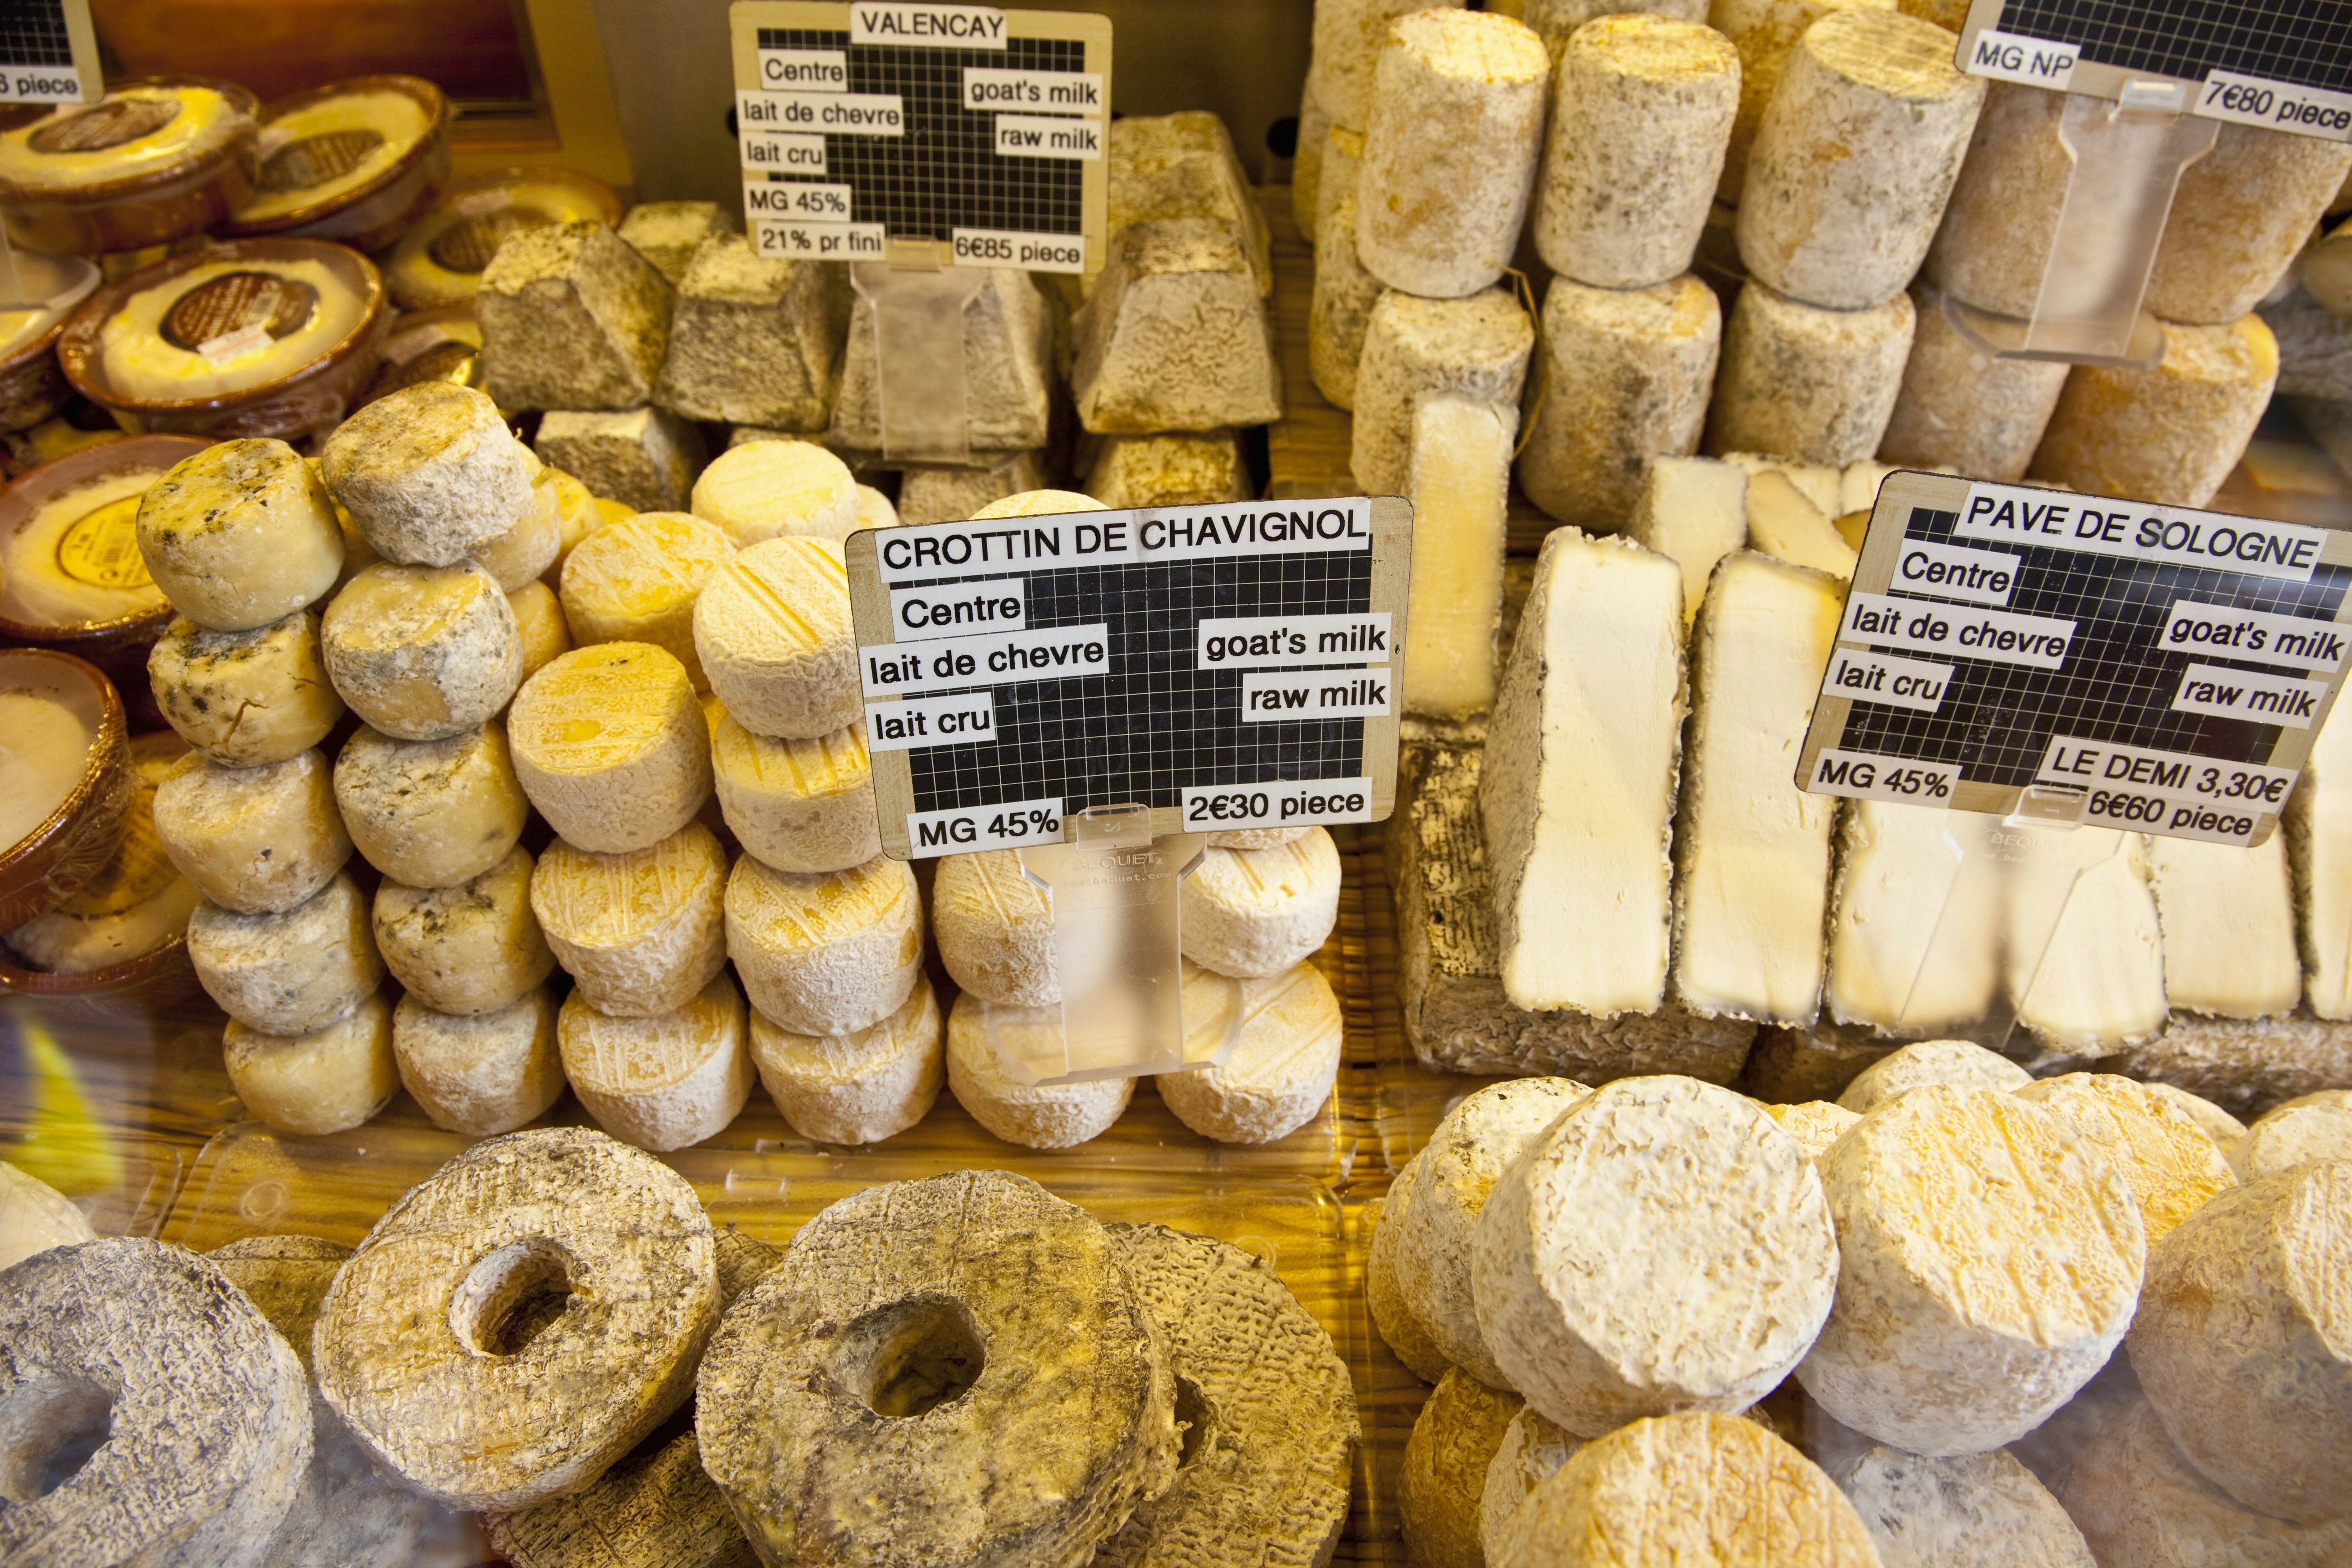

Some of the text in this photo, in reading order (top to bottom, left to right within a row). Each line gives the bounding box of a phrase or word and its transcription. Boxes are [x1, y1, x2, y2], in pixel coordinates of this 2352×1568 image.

[861, 11, 1003, 37] VALENCAY
[765, 58, 844, 82] Centre
[1975, 41, 2073, 77] MG NP
[16, 73, 78, 97] piece
[972, 80, 1097, 104] goat's milk
[745, 100, 899, 126] lait de chevre
[2207, 81, 2352, 130] 7€80 piece
[748, 141, 822, 164] lait cru
[1002, 129, 1097, 150] raw milk
[750, 190, 845, 213] MG 45%
[763, 229, 882, 252] 21% pr fini
[955, 237, 1080, 264] 6€85 piece
[884, 509, 1366, 569] CROTTIN DE CHAVIGNOL
[1967, 496, 2319, 568] PAVE DE SOLOGNE
[1902, 552, 2010, 592] Centre
[902, 596, 1020, 628] Centre
[1207, 625, 1385, 661] goat's milk
[1852, 604, 2065, 657] lait de chevre
[2170, 619, 2345, 661] goat's milk
[870, 642, 1103, 684] lait de chevre
[1836, 660, 1942, 700] lait cru
[1251, 680, 1385, 710] raw milk
[2184, 682, 2316, 717] raw milk
[876, 710, 990, 739] lait cru
[1818, 759, 1948, 797] MG 45%
[2052, 747, 2288, 802] LE DEMI 3,30€
[1190, 791, 1364, 821] 2€30 piece
[2089, 791, 2252, 835] 6€60 piece
[919, 809, 1059, 846] MG 45%
